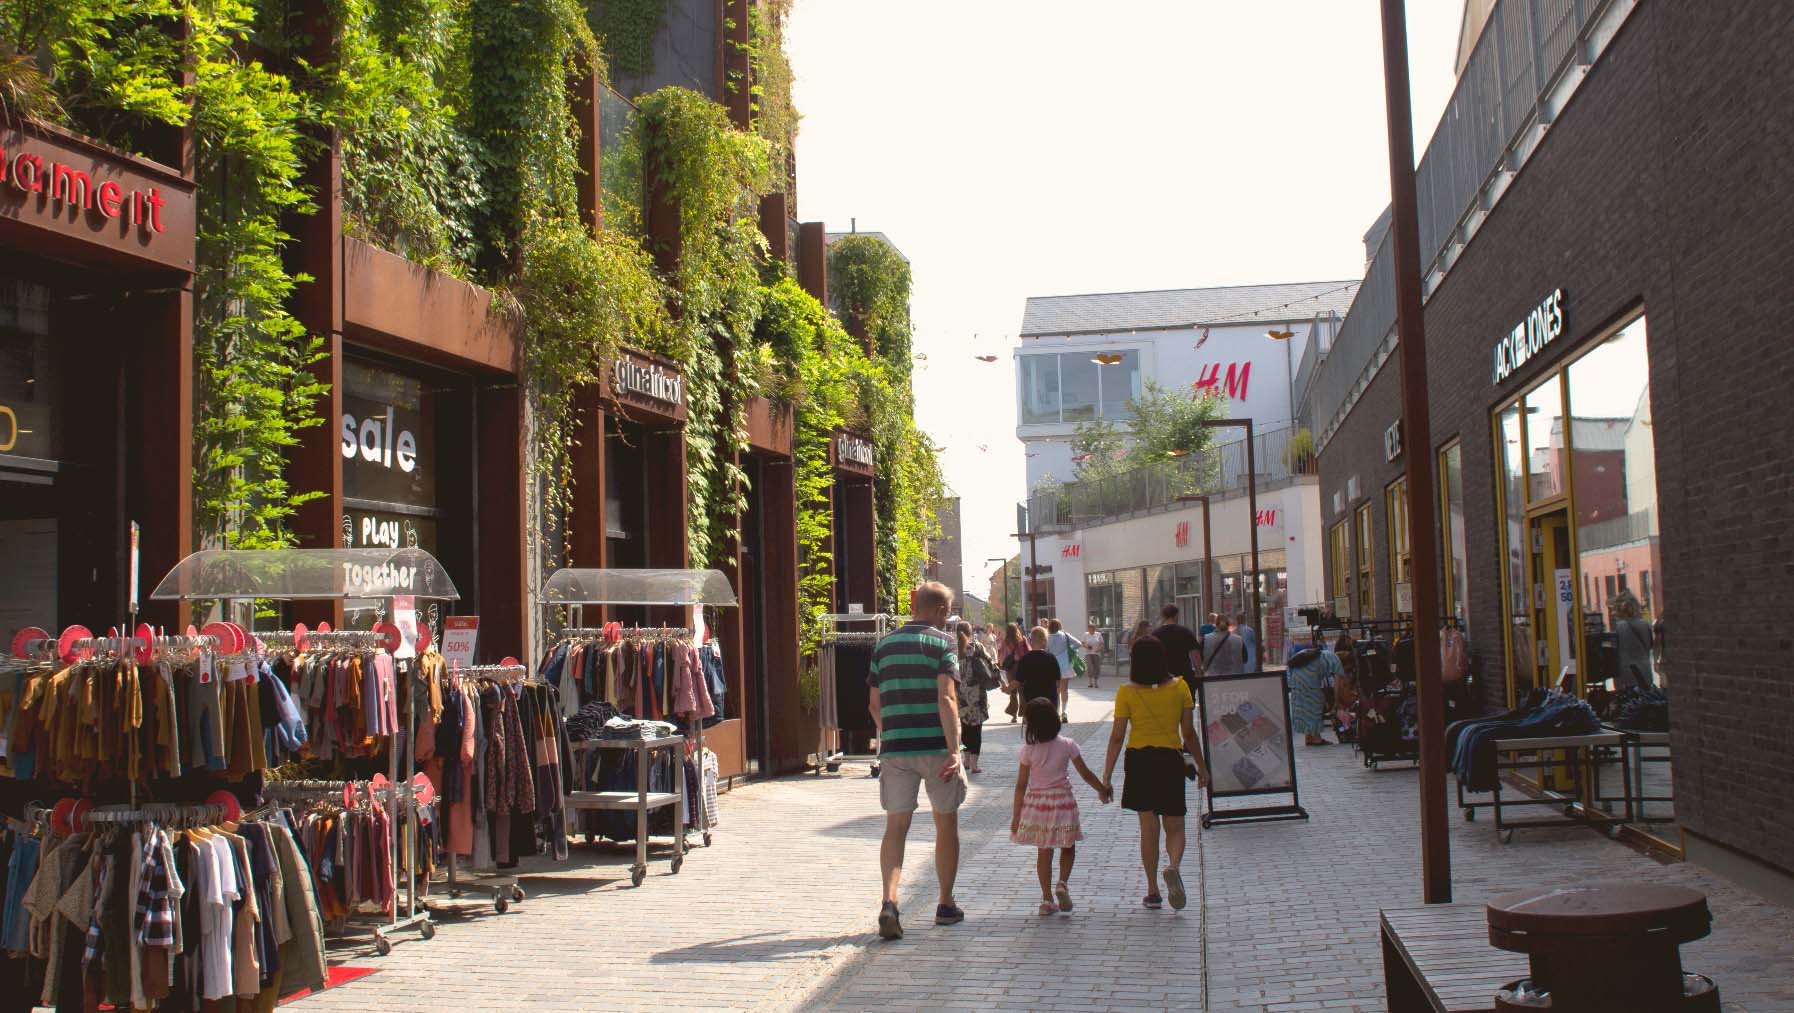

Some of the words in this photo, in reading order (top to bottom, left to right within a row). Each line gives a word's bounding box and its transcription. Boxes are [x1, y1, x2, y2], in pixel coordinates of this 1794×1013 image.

[0, 147, 122, 218] ame
[1526, 288, 1562, 359] JONES
[341, 405, 417, 473] sale
[362, 516, 399, 549] Play
[343, 562, 417, 593] Together
[447, 641, 470, 653] 50%
